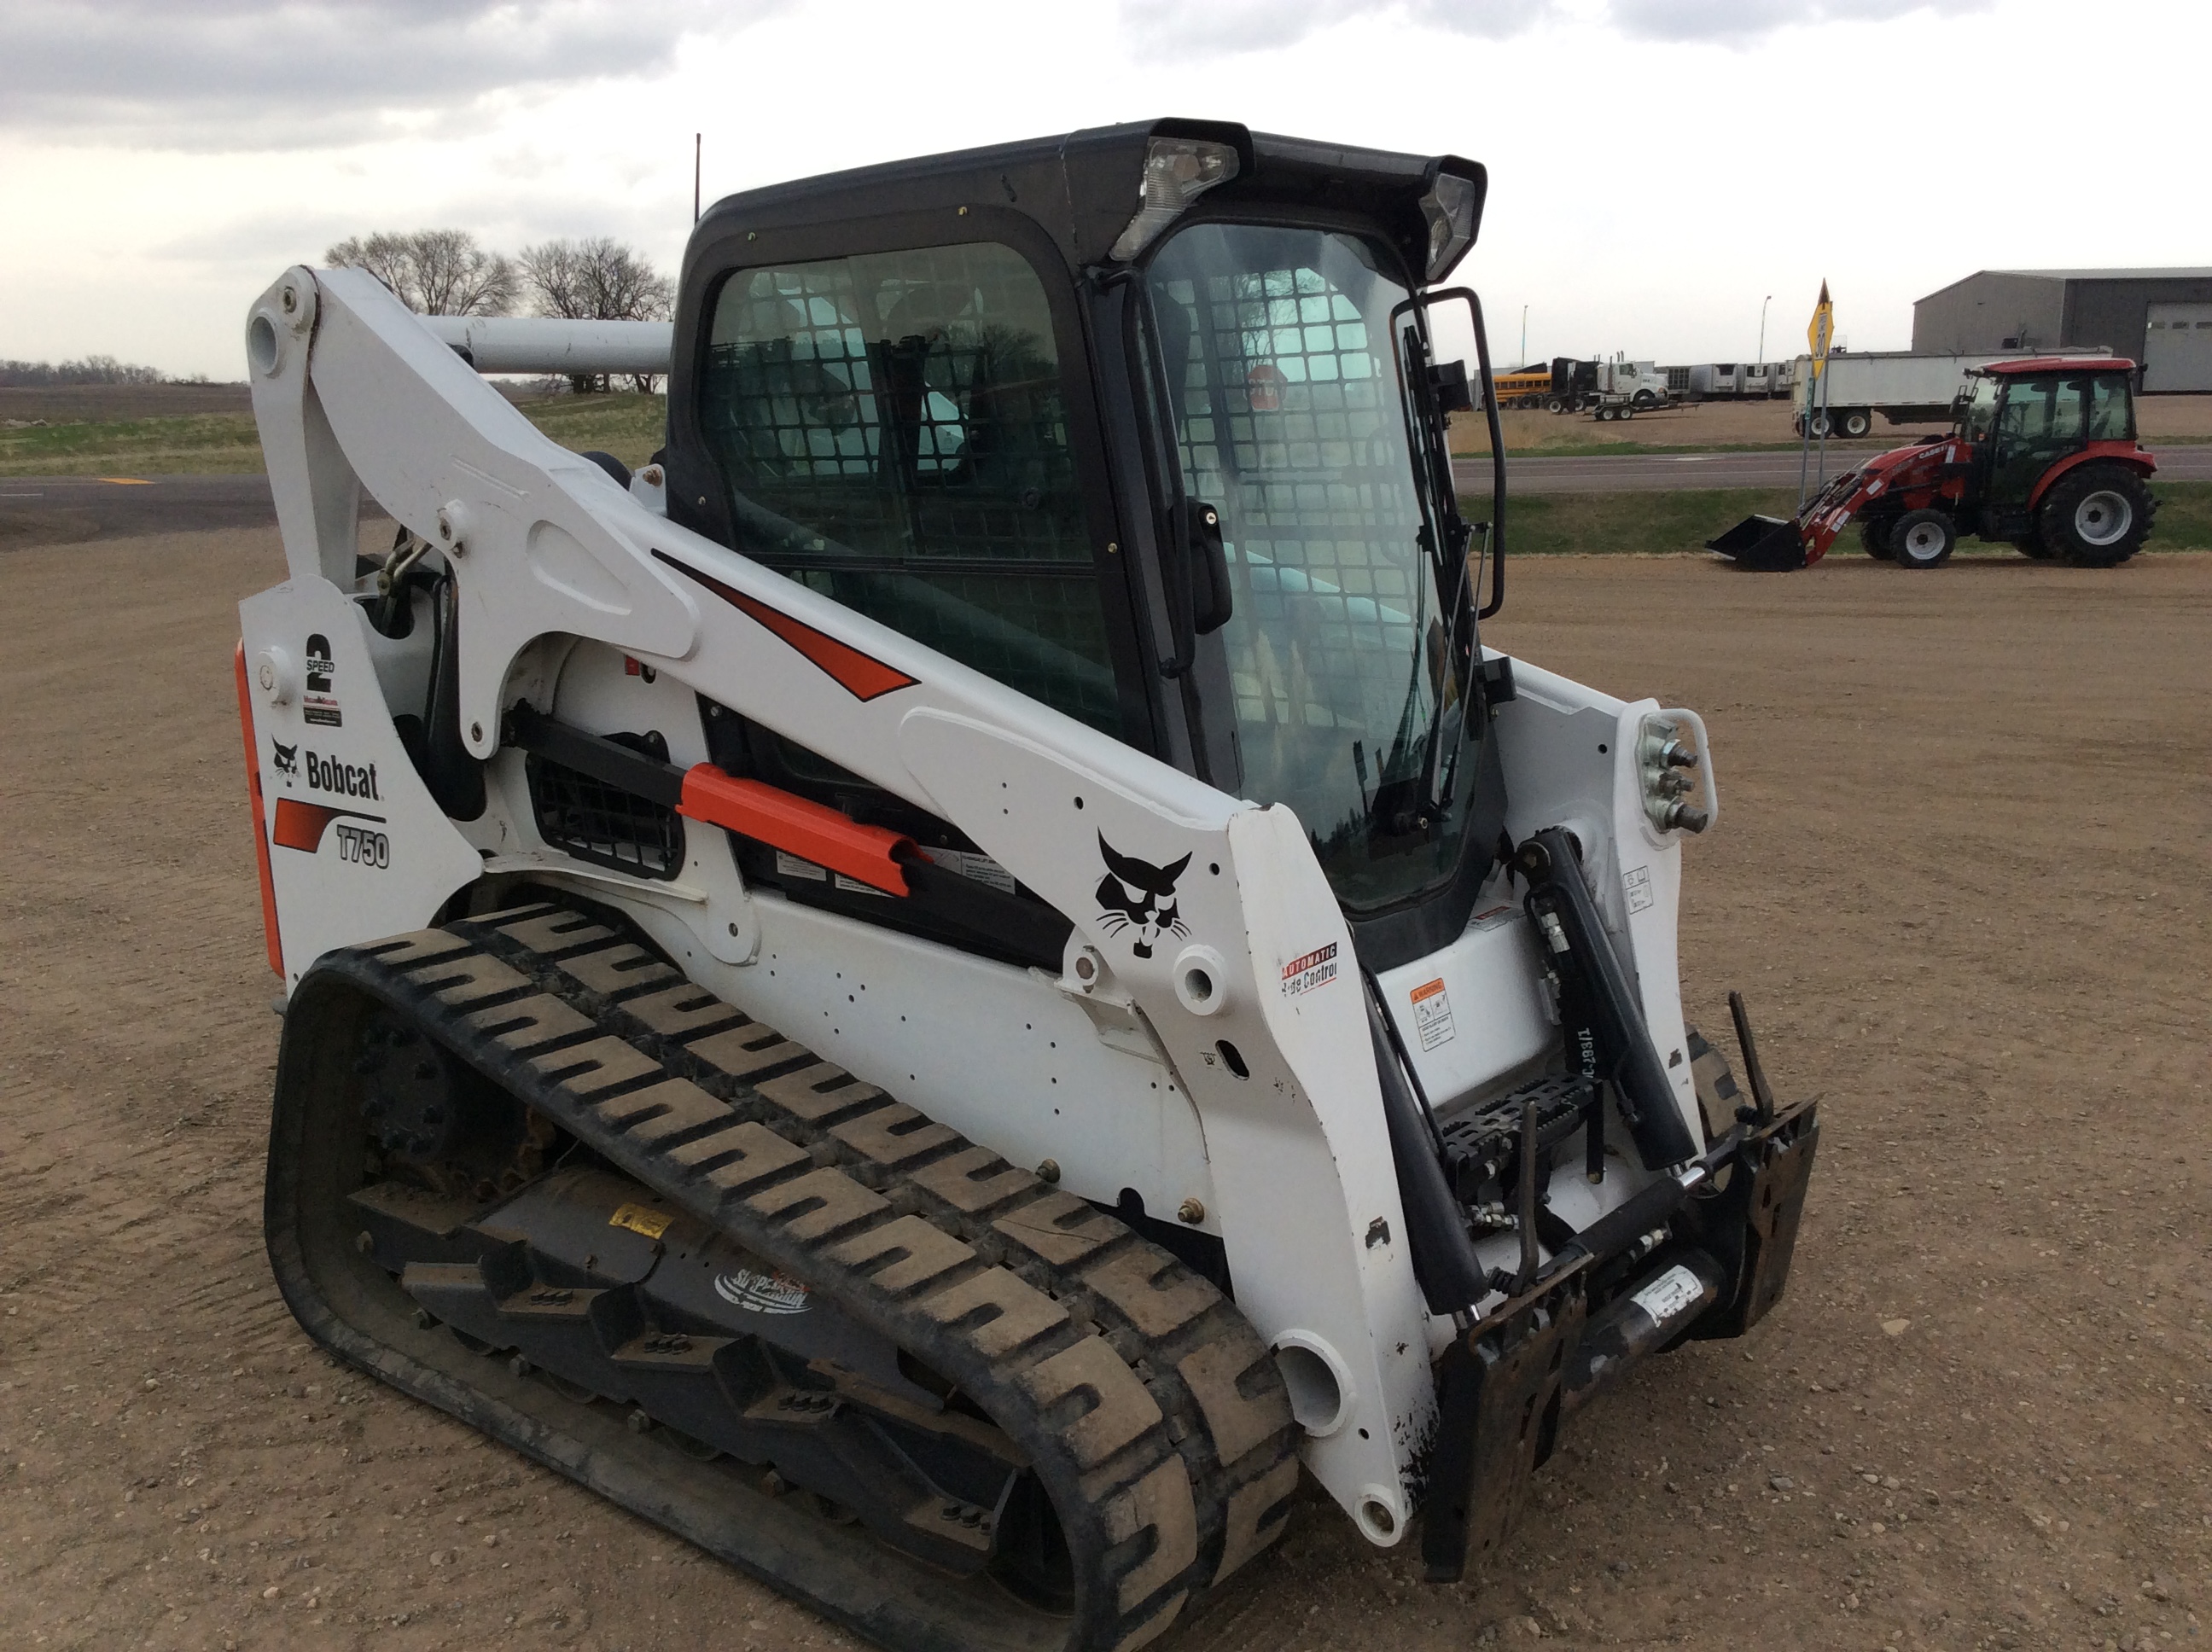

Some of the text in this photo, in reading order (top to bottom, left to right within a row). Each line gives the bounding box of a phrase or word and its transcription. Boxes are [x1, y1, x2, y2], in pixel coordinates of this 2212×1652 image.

[306, 660, 335, 673] SPEED
[306, 750, 379, 800] Bobcat
[337, 824, 389, 869] T750
[1282, 945, 1336, 979] AUTOMATIC
[1304, 962, 1337, 988] Control
